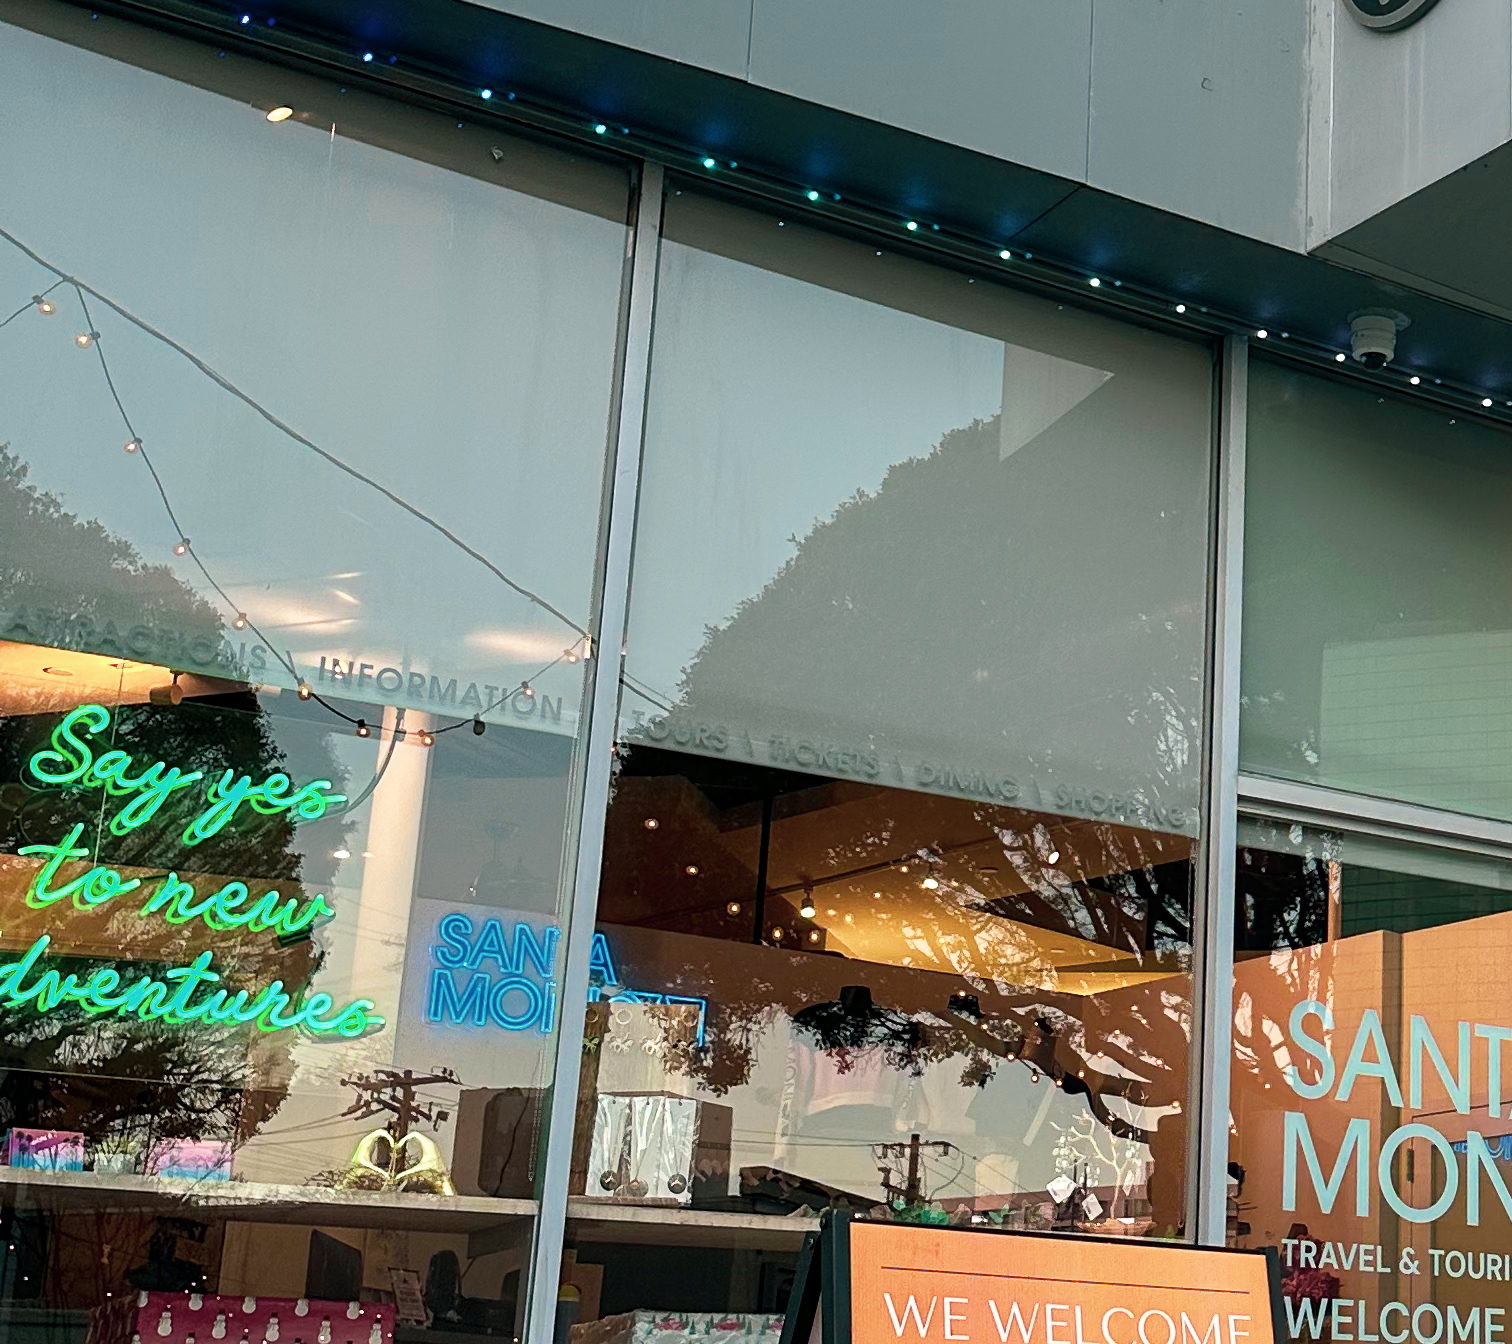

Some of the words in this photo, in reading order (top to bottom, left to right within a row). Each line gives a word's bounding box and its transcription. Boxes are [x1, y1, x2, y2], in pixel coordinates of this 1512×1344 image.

[317, 655, 563, 722] INFORMATION
[20, 704, 203, 836] Say
[183, 768, 348, 846] yes
[17, 822, 142, 911] to
[141, 870, 336, 935] new
[0, 934, 386, 1037] dventures
[436, 913, 618, 988] SANA
[1280, 1238, 1391, 1273] TRAVEL
[1398, 1247, 1420, 1276] &
[883, 1292, 971, 1341] WE
